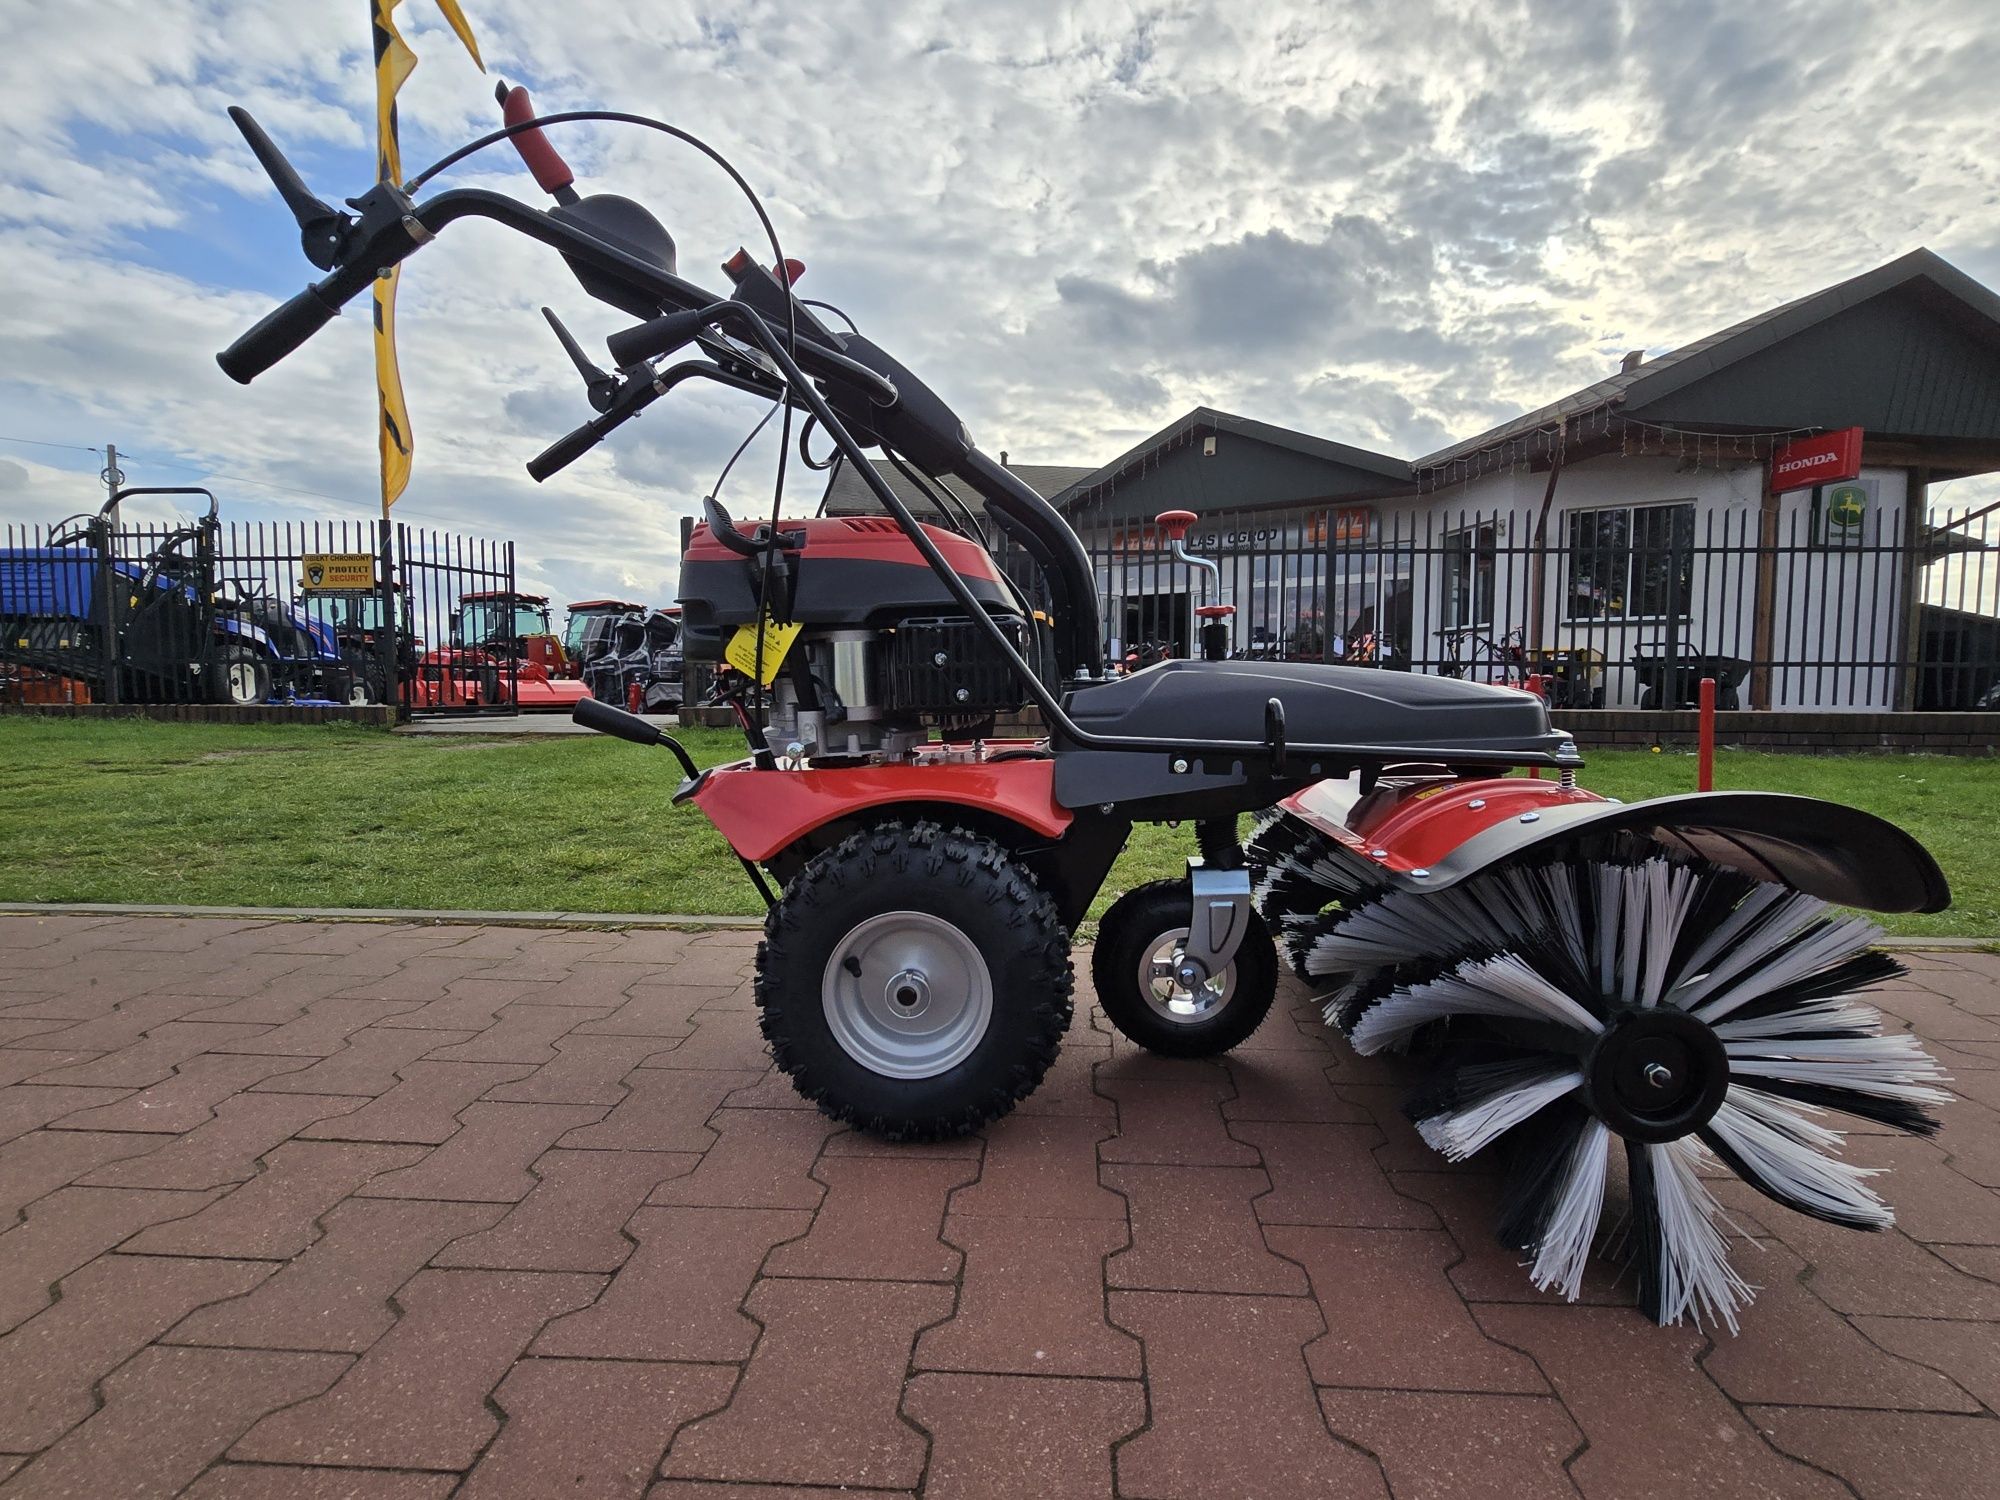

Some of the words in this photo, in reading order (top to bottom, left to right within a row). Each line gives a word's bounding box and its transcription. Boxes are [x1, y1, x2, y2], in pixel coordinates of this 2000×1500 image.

[1778, 453, 1838, 473] HONDA
[1190, 534, 1216, 547] LAS
[330, 574, 368, 582] SECURITY
